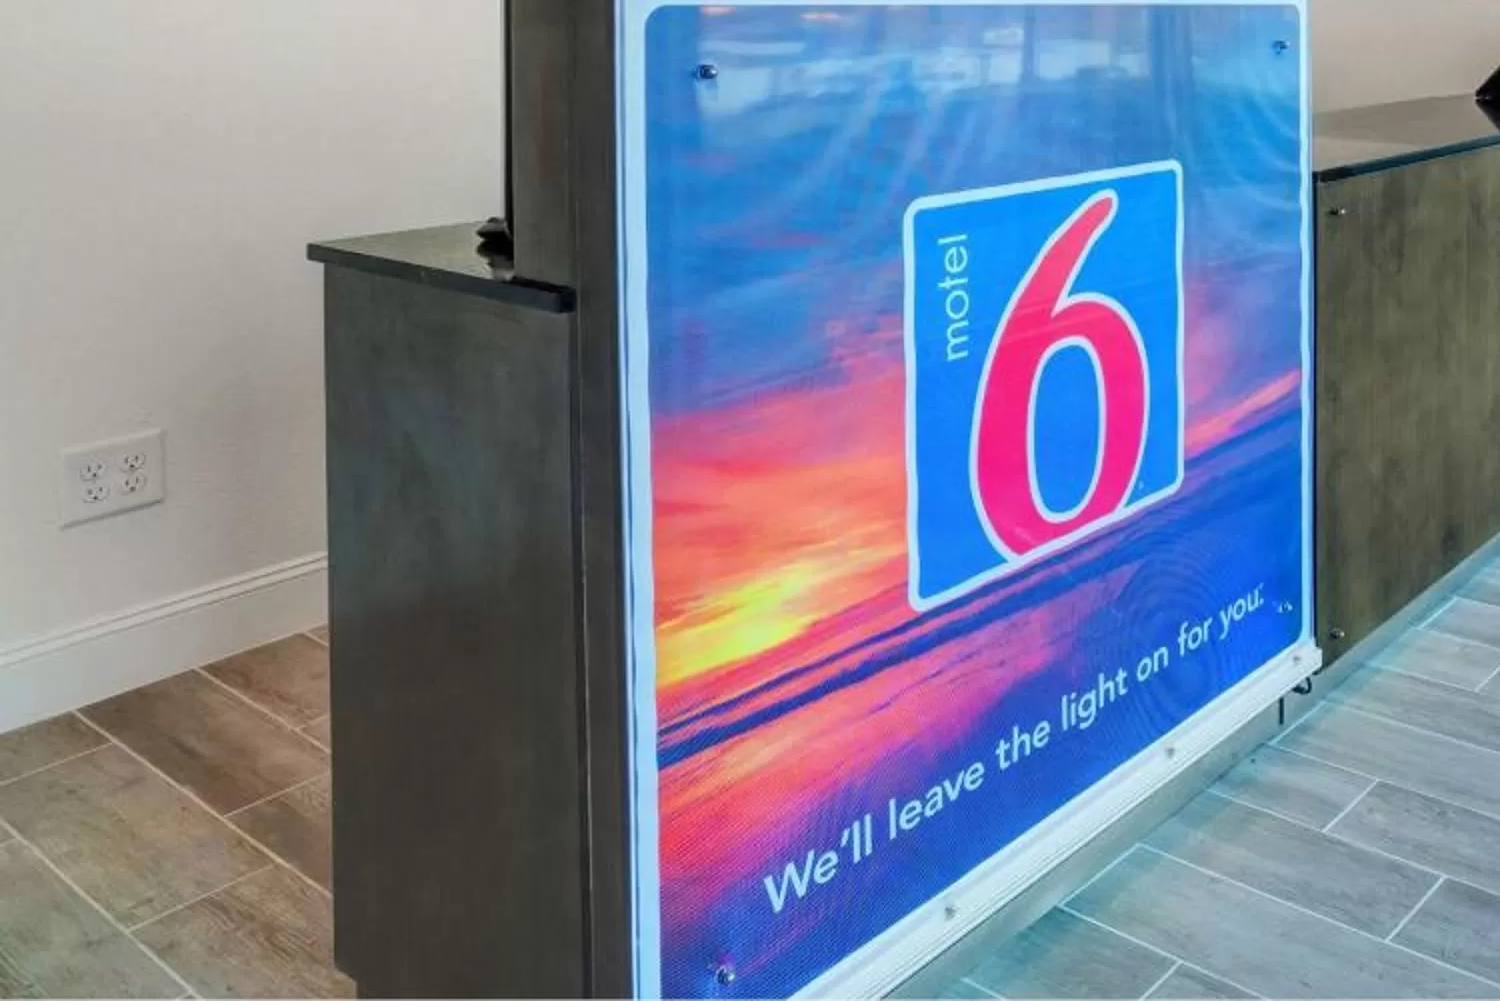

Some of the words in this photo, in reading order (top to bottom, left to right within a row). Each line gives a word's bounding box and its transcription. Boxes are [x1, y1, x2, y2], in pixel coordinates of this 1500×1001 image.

[937, 233, 970, 362] motel
[969, 188, 1150, 563] 6
[763, 813, 873, 913] We'll
[888, 762, 985, 841] leave
[995, 719, 1051, 772] the
[1060, 667, 1129, 732] light
[1136, 646, 1169, 683] on
[1176, 621, 1213, 656] for
